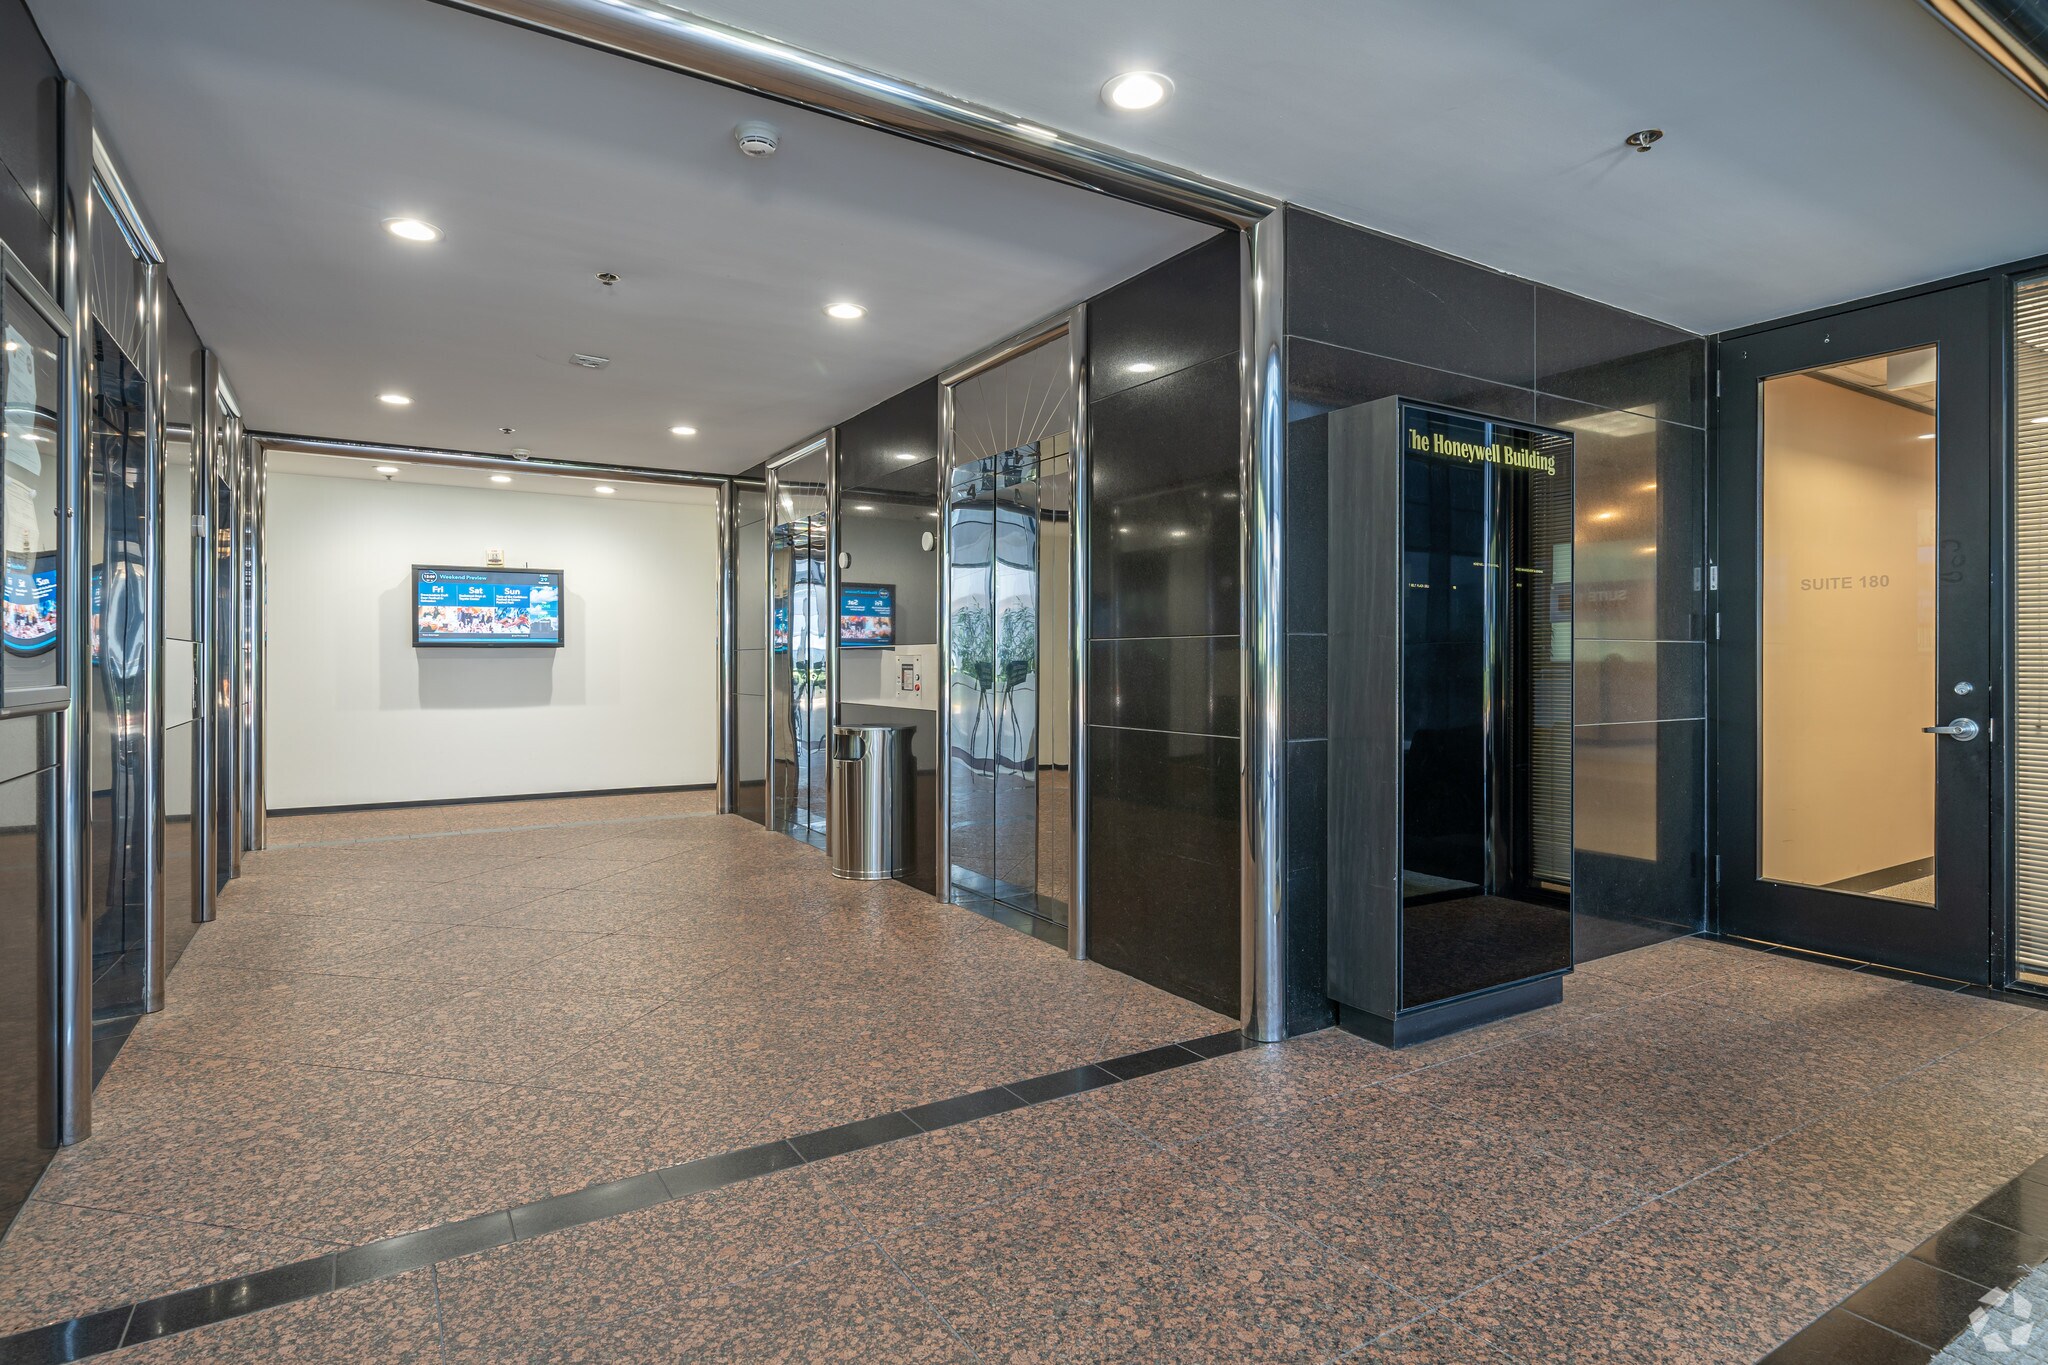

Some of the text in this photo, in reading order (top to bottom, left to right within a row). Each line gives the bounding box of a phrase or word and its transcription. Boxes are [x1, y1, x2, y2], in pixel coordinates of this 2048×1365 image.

[1434, 433, 1500, 463] Honeywell
[1504, 447, 1555, 475] Building
[1801, 575, 1889, 590] SUITE 180
